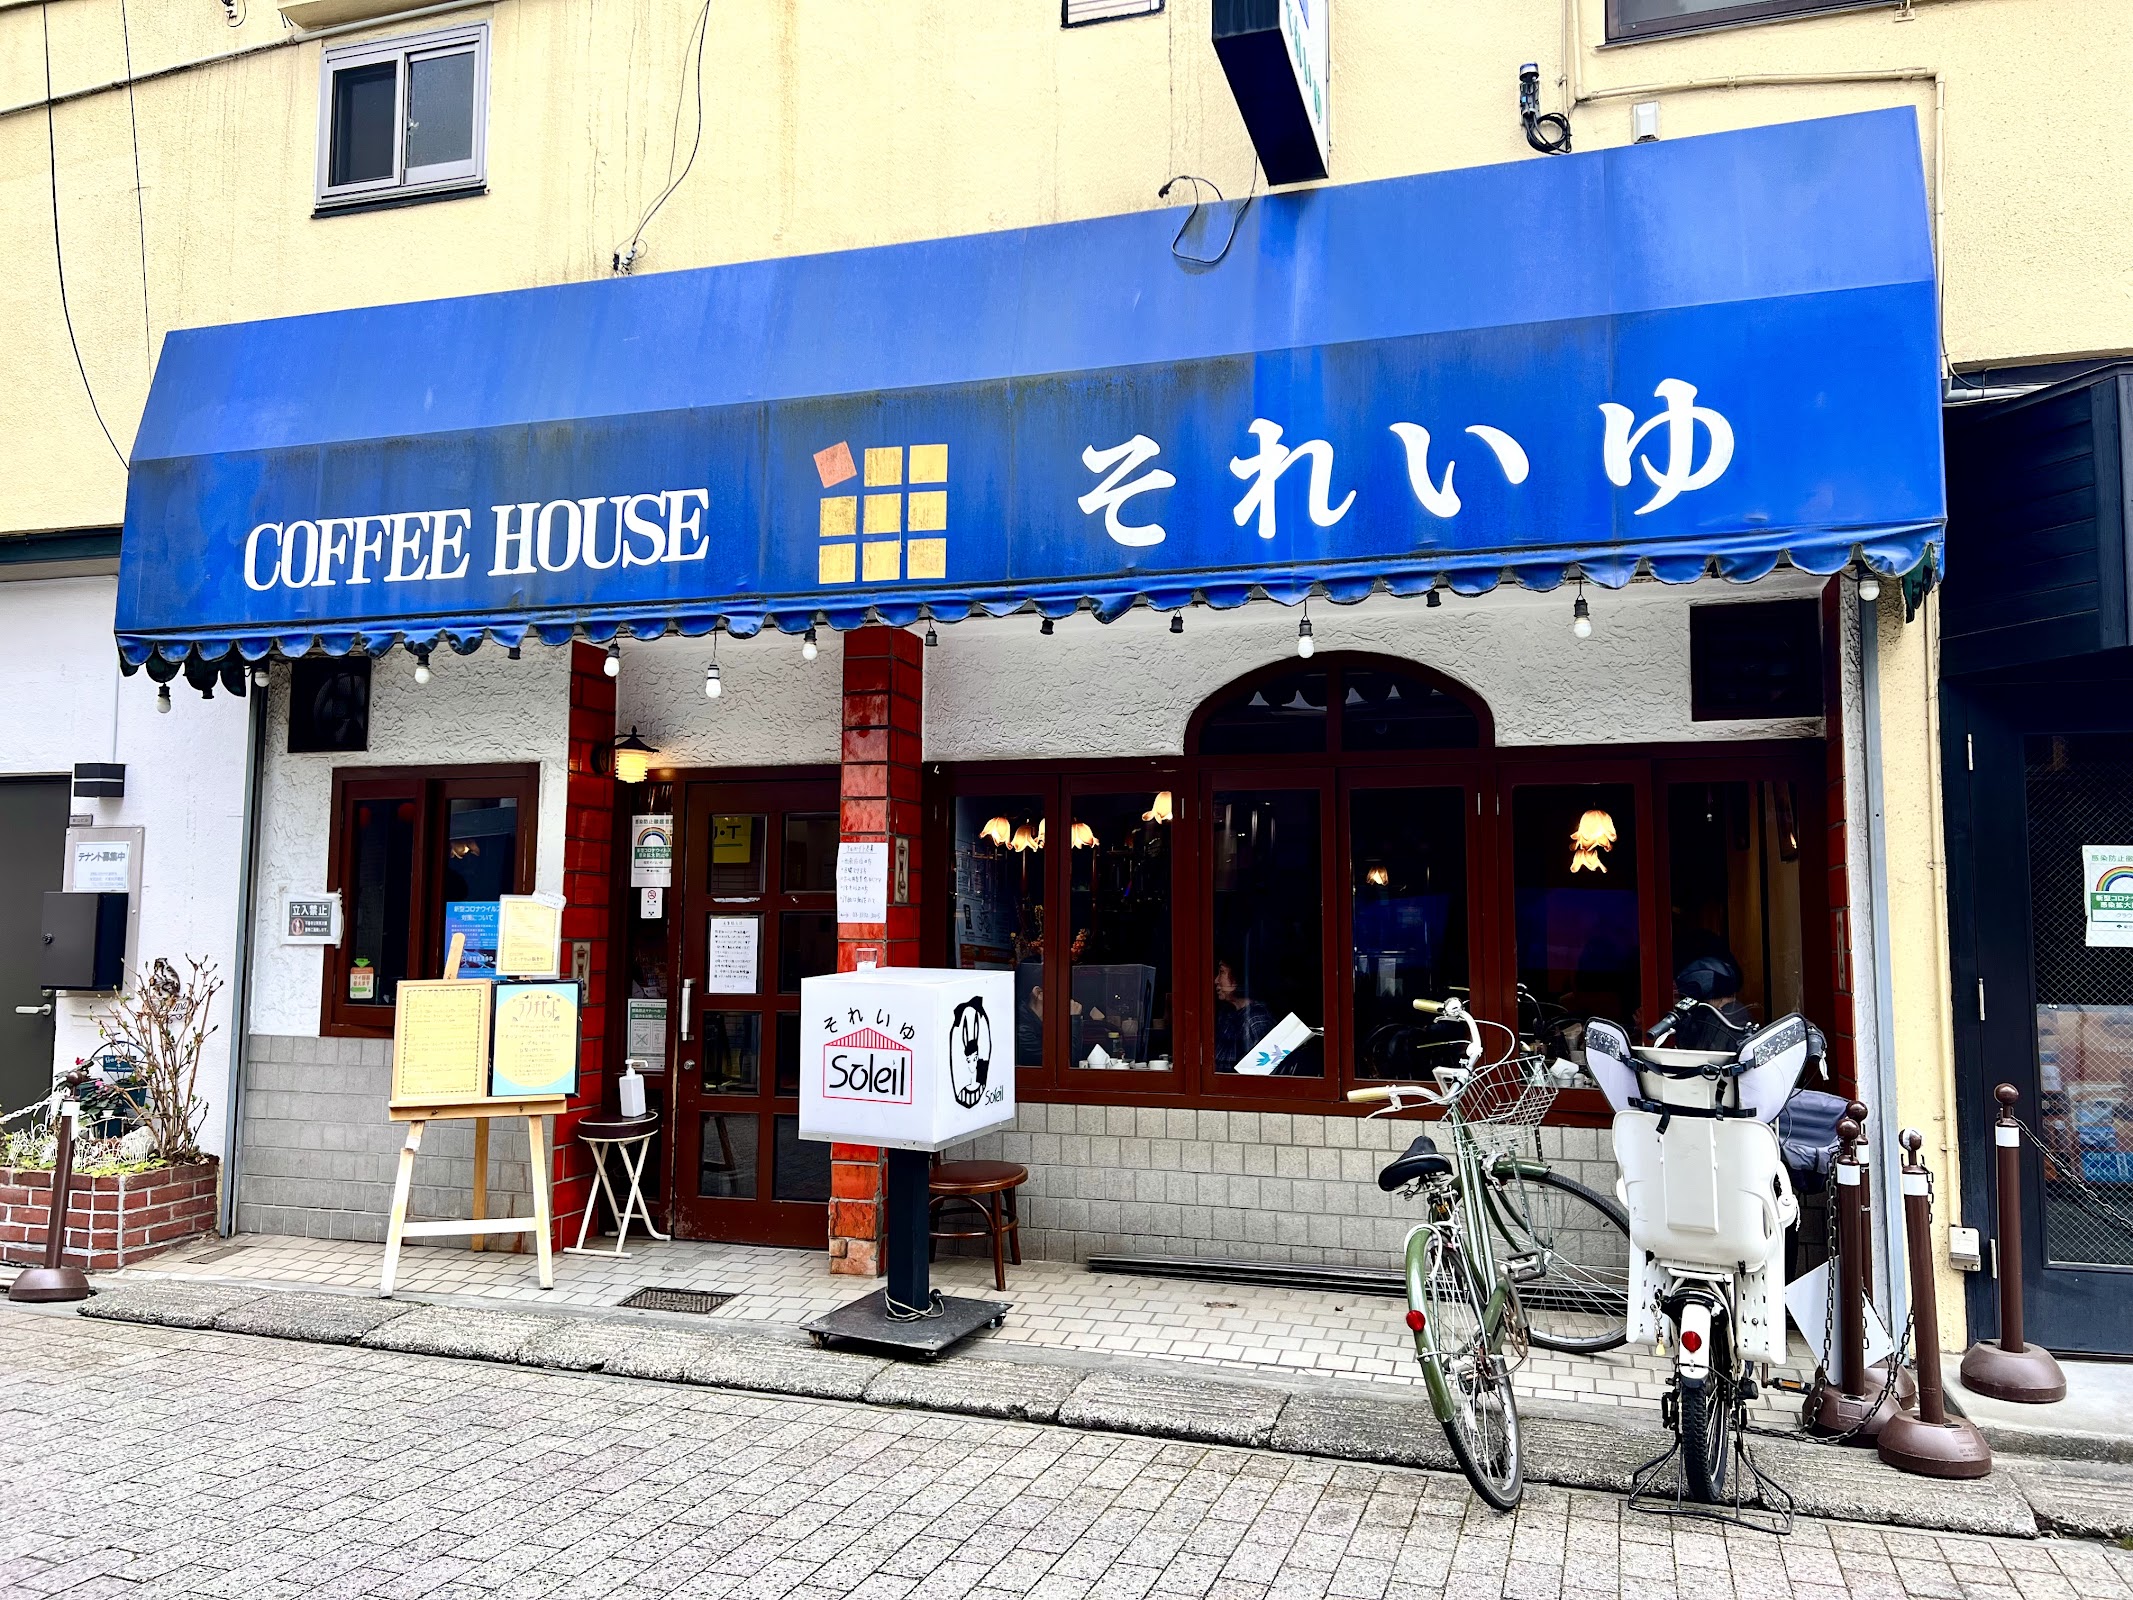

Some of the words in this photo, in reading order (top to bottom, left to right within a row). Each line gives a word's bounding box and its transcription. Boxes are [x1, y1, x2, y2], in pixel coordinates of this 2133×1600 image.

[1077, 377, 1735, 547] それいゆ
[243, 508, 471, 591] COFFEE
[488, 488, 710, 578] HOUSE
[78, 852, 126, 861] テナント募集中
[292, 905, 328, 916] 立入禁止
[823, 1007, 915, 1040] それいゆ
[829, 1053, 906, 1096] Soleil
[984, 1085, 1004, 1106] Soleil
